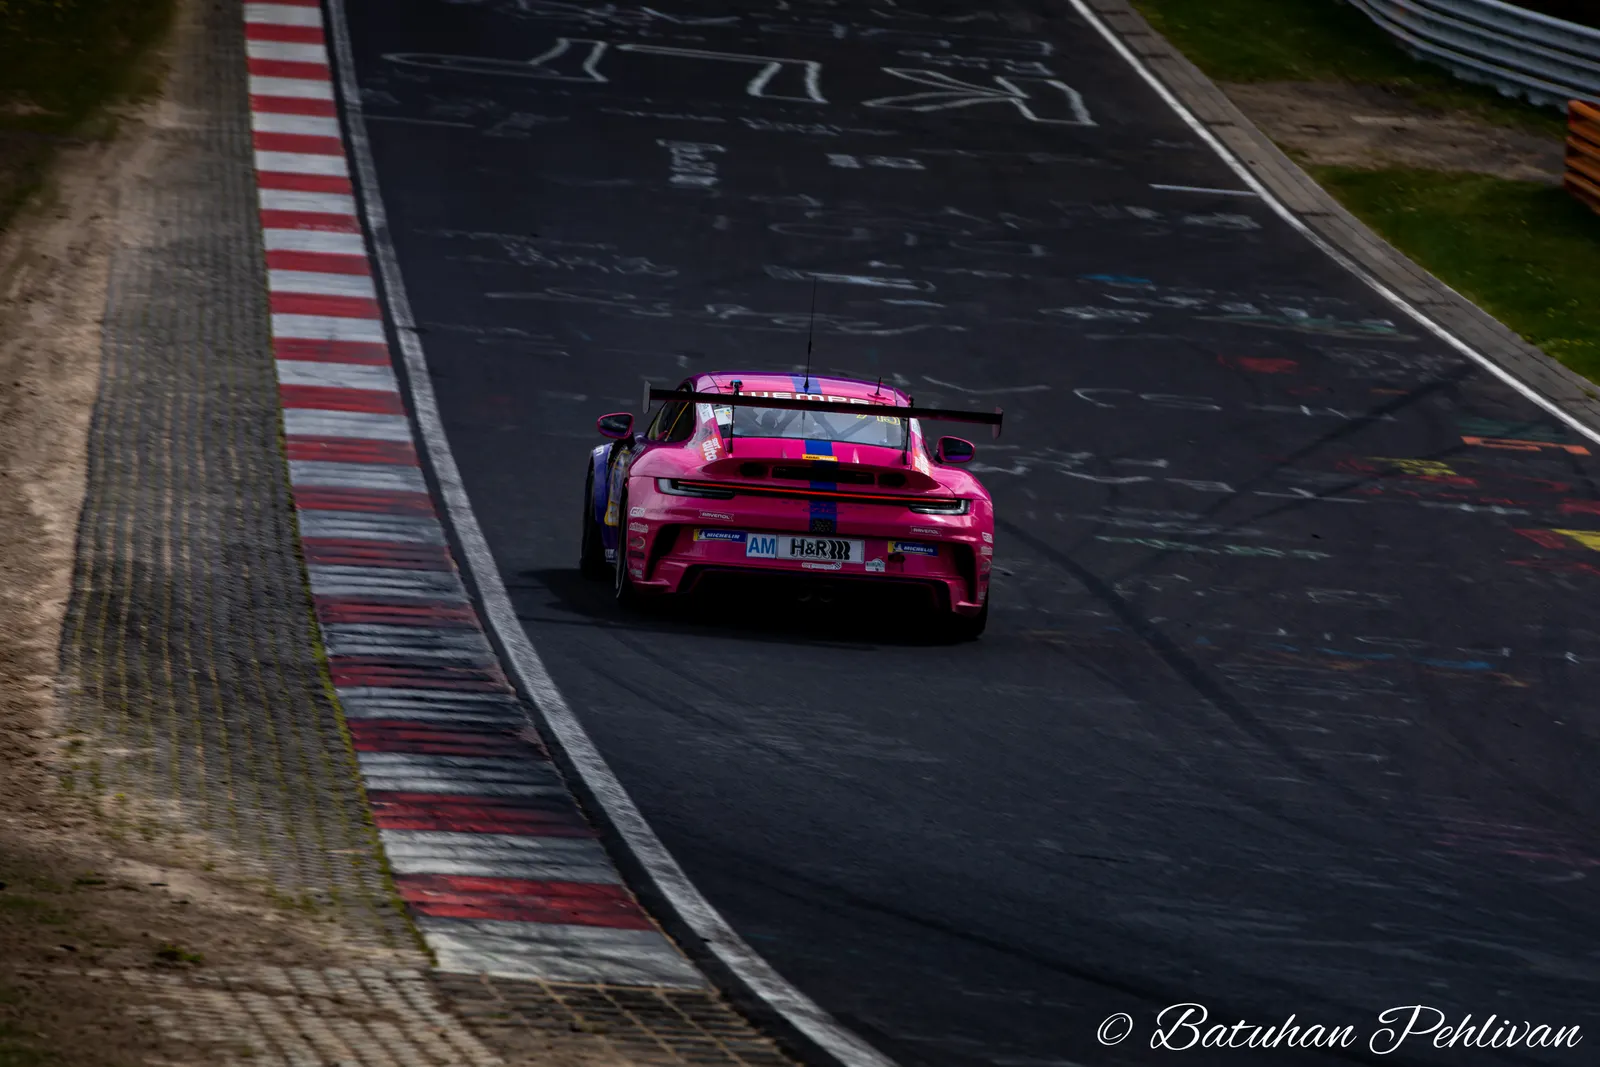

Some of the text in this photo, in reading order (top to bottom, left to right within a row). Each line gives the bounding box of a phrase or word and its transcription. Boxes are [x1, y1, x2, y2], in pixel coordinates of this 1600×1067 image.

[701, 511, 731, 520] RAVENOL
[706, 532, 741, 540] MICHELIN
[748, 537, 776, 555] AM
[790, 537, 828, 558] H&R
[903, 545, 934, 554] MICHELIN
